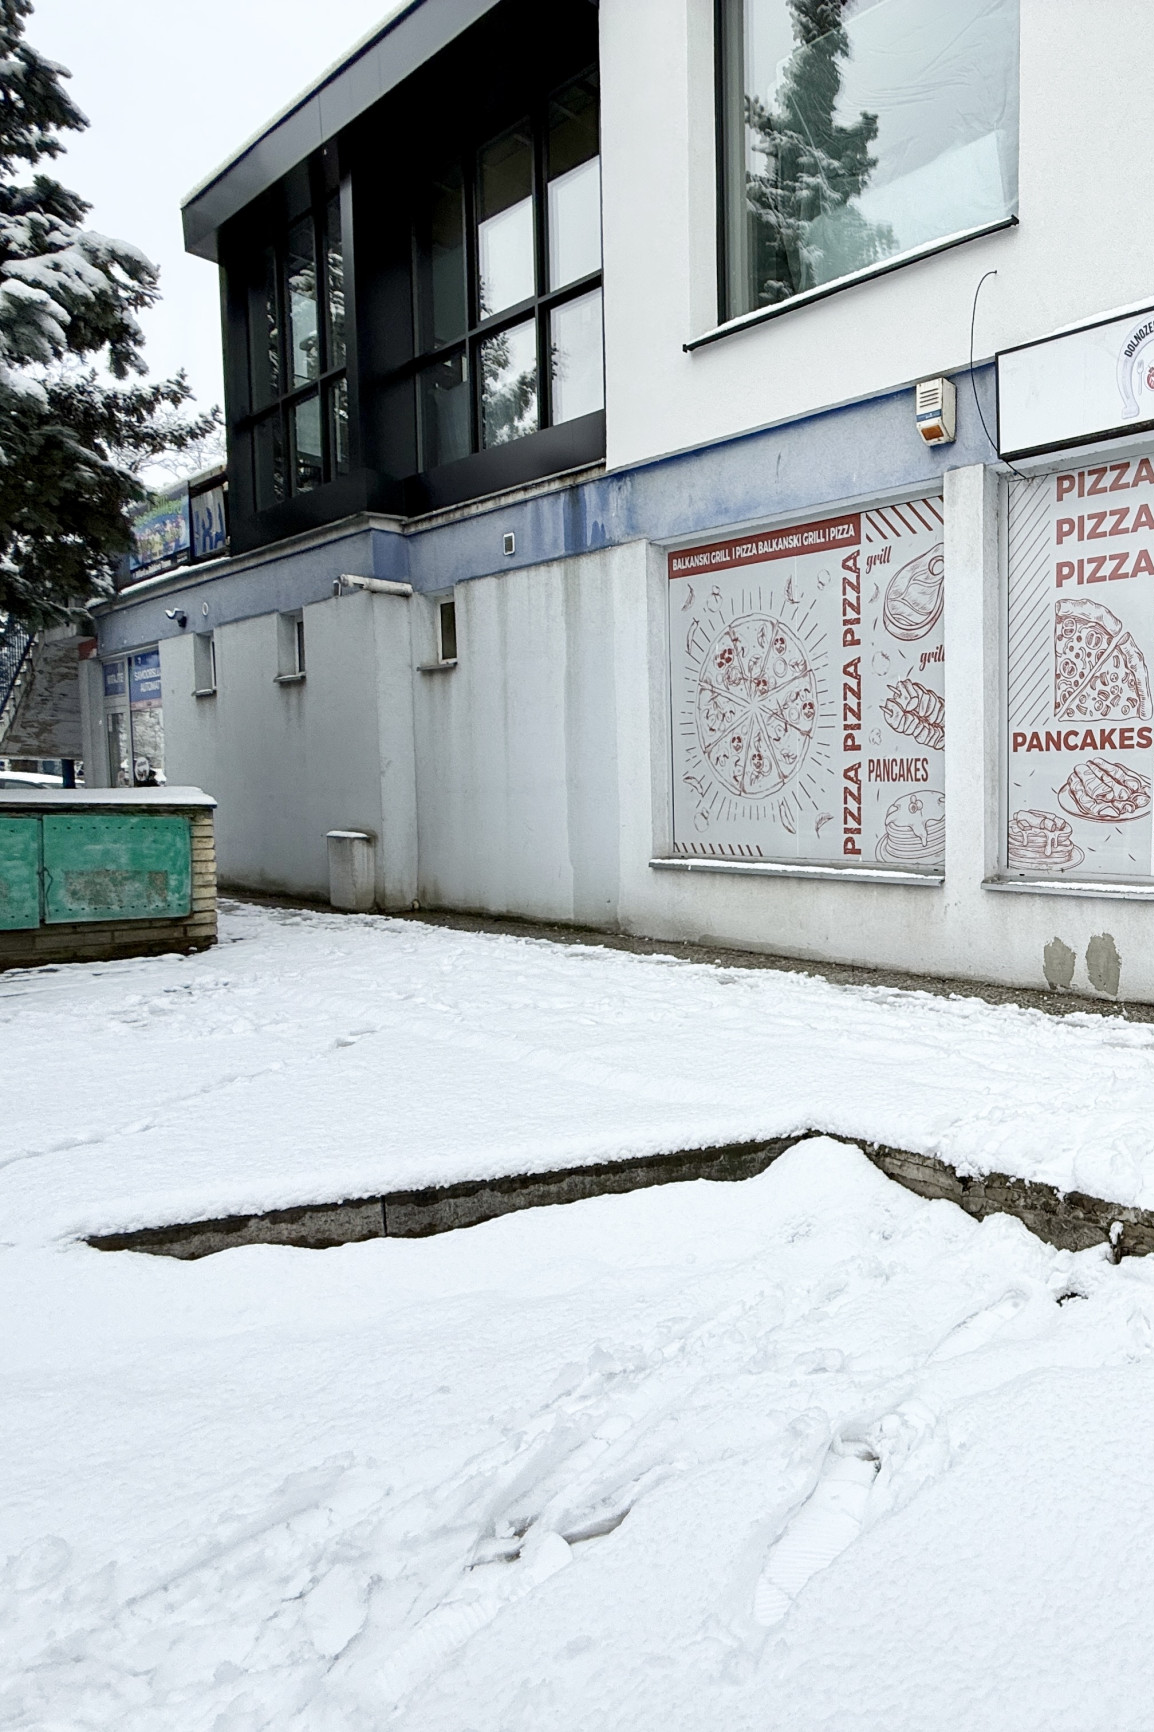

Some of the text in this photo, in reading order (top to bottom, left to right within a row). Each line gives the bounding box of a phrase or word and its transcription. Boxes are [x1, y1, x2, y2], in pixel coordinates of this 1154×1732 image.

[673, 555, 710, 571] BALKANSKI
[711, 552, 730, 565] GRILL
[736, 543, 758, 558] PIZZA
[758, 534, 802, 554] BALKANSKI
[803, 530, 825, 545] GRILL
[830, 523, 855, 540] PIZZA
[866, 545, 892, 574] grill
[841, 549, 862, 855] PIZZA PIZZA PIZZA
[1012, 726, 1153, 753] PANCAKES
[868, 757, 929, 782] PANCAKES
